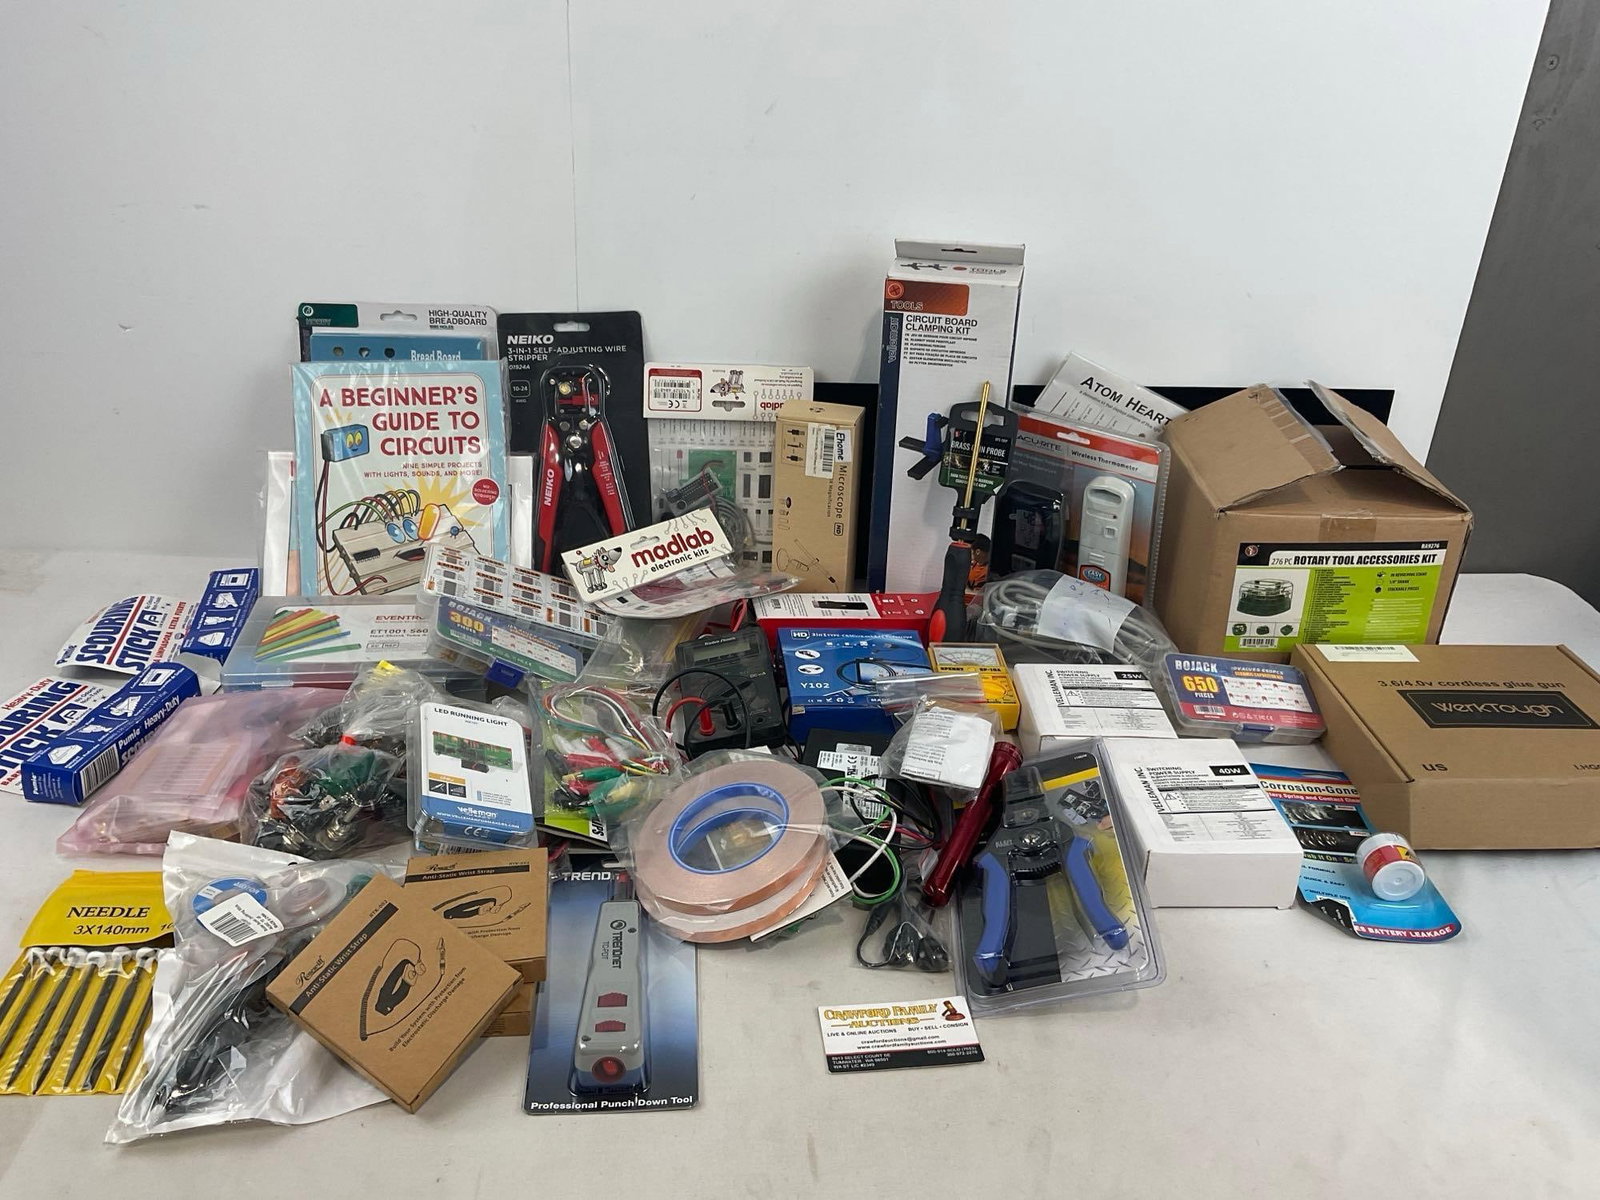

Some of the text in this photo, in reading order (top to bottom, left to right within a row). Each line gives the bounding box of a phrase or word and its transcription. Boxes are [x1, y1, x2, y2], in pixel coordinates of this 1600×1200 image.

[429, 310, 487, 318] HIGH-QUALITY
[890, 300, 924, 311] TOOLS
[429, 318, 487, 326] BREADBOARD
[905, 323, 971, 335] CLAMPING KIT
[906, 315, 978, 327] CIRCUIT BOARD
[507, 335, 554, 345] NEIKO
[533, 345, 603, 353] SELF-ADJUSTING
[411, 350, 461, 361] Bread Board
[508, 354, 548, 362] STRIPPER
[319, 386, 478, 407] A BEGINNER'S
[1080, 376, 1124, 403] ATOM
[1126, 397, 1173, 426] HEART
[372, 411, 480, 431] GUIDE TO
[380, 436, 481, 456] CIRCUITS
[835, 432, 846, 461] Ehome
[951, 440, 1006, 458] BRASS PROBE
[1071, 449, 1097, 462] Wireless
[1098, 456, 1139, 472] Thermometer
[543, 468, 555, 507] NEIKO
[836, 464, 847, 519] Microscope
[631, 527, 714, 568] madlab
[650, 548, 710, 573] electronic kits
[1293, 556, 1331, 565] ROTARY
[1332, 555, 1355, 565] TOOL
[1356, 554, 1422, 565] ACCESSORIES
[1422, 554, 1438, 563] KIT
[168, 611, 181, 630] EXTRA
[448, 601, 494, 623] BOJACK
[449, 612, 485, 633] 300
[115, 630, 161, 672] STICK
[1175, 660, 1217, 673] BOJACK
[1049, 679, 1065, 707] VELLEMAN
[1182, 674, 1219, 693] 650
[1377, 679, 1566, 689] 3.6/4.0v cordless glue gun
[2, 678, 54, 711] Heavy-Duty
[118, 695, 179, 750] Pumie Heavy-Duty
[450, 711, 485, 723] RUNNING
[486, 718, 509, 727] LIGHT
[1133, 766, 1165, 813] VELLEMAN INC
[457, 806, 498, 819] velleman
[422, 872, 457, 880] Anti-Static
[67, 907, 150, 918] NEEDLE
[73, 925, 150, 935] 3X140mm
[1368, 926, 1452, 938] BATTERY LEAKAGE
[305, 932, 369, 999] Anti-Static Wrist Strap
[410, 1010, 428, 1029] System
[434, 977, 457, 1003] Protection
[454, 967, 467, 981] from
[402, 977, 466, 1048] Electrostatic Discharge Damage
[848, 1018, 920, 1029] AUCTIONS
[531, 1095, 693, 1110] Professional Punch Down Tool
